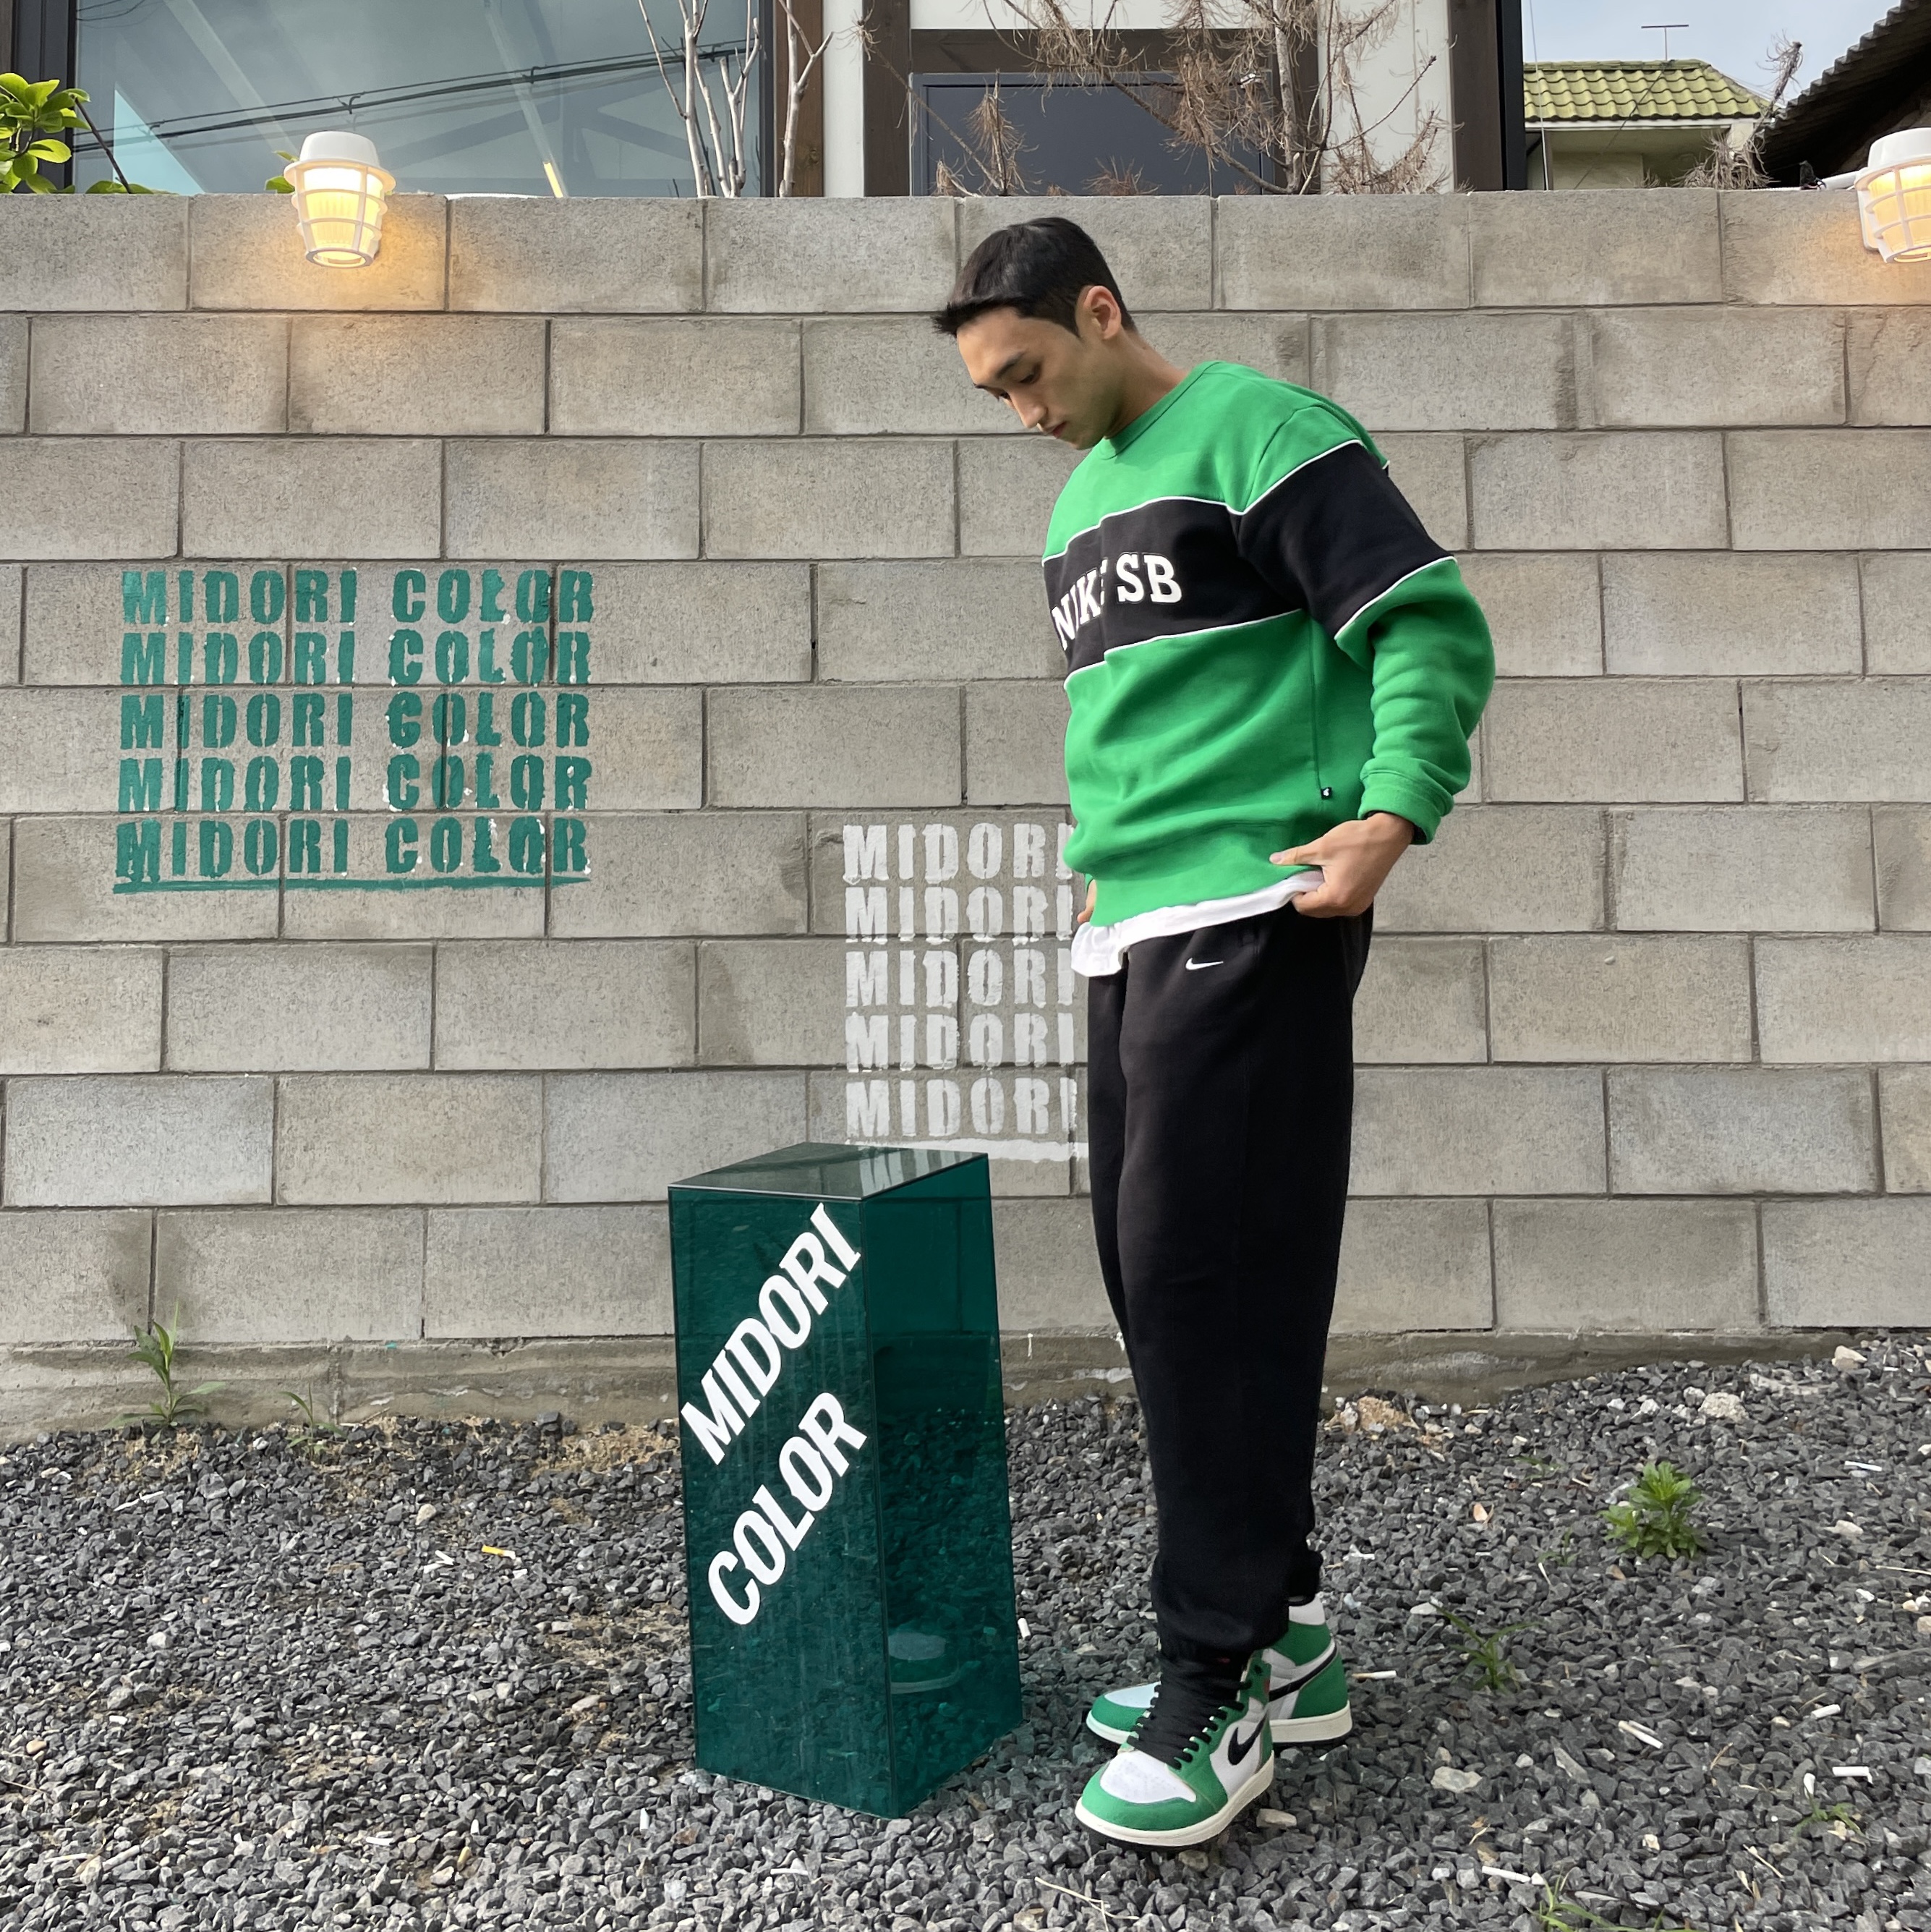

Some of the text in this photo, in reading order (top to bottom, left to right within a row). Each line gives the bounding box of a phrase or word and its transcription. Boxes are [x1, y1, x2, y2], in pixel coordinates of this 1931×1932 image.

[122, 569, 594, 624] MIDORI COLOR
[1116, 553, 1182, 603] SB
[121, 628, 591, 686] MIDORI COLOR
[120, 691, 589, 749] MIDORI COLOR
[119, 753, 592, 812] MIDORI COLOR
[116, 817, 588, 882] MIDORI COLOR
[843, 822, 1075, 885] MIDORI
[845, 885, 1074, 945] MIDORI
[845, 948, 1075, 1008] MIDORI
[845, 1012, 1075, 1073] MIDORI
[845, 1077, 1078, 1138] MIDORI
[681, 1202, 861, 1465] MIDORI
[708, 1392, 867, 1625] COLOR
